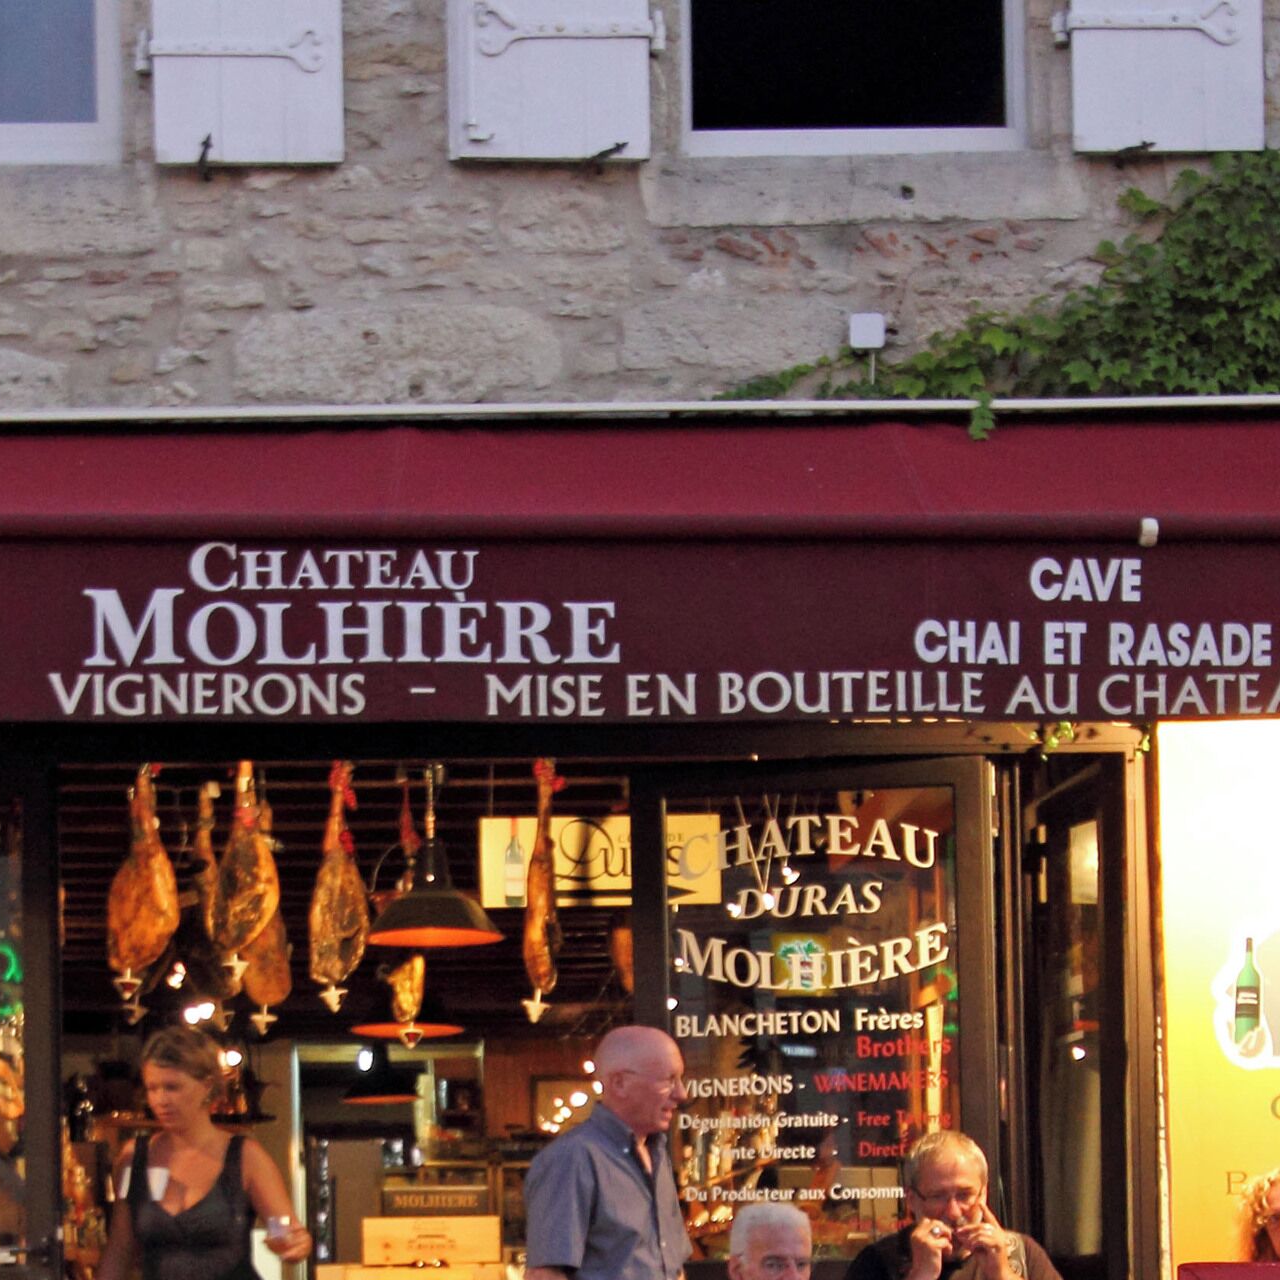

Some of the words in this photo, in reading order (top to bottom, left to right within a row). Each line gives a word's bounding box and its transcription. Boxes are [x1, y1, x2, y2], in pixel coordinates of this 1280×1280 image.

[189, 542, 478, 592] CHATEAU
[1030, 558, 1141, 602] CAVE
[82, 587, 620, 668] MOLHIÈRE
[914, 621, 1019, 666] CHAI
[1043, 622, 1087, 665] ET
[1109, 623, 1271, 667] RASADE
[48, 672, 366, 716] VIGNERONS
[485, 673, 605, 717] MISE
[628, 673, 697, 717] EN
[720, 671, 983, 715] BOUTEILLE
[1005, 672, 1078, 715] AU
[678, 815, 939, 880] CHATEAU
[735, 881, 883, 920] DURAS
[676, 922, 949, 991] MOLHIÈRE
[675, 1009, 840, 1038] BLANCHETON
[855, 1007, 924, 1031] Frères
[856, 1034, 952, 1059] Brothers
[775, 1111, 839, 1128] Gratuite
[858, 1111, 890, 1127] Free
[761, 1145, 816, 1160] Directe
[685, 1187, 708, 1202] Du
[712, 1185, 796, 1201] Producteur
[799, 1187, 826, 1200] aux
[830, 1184, 906, 1200] Consomm
